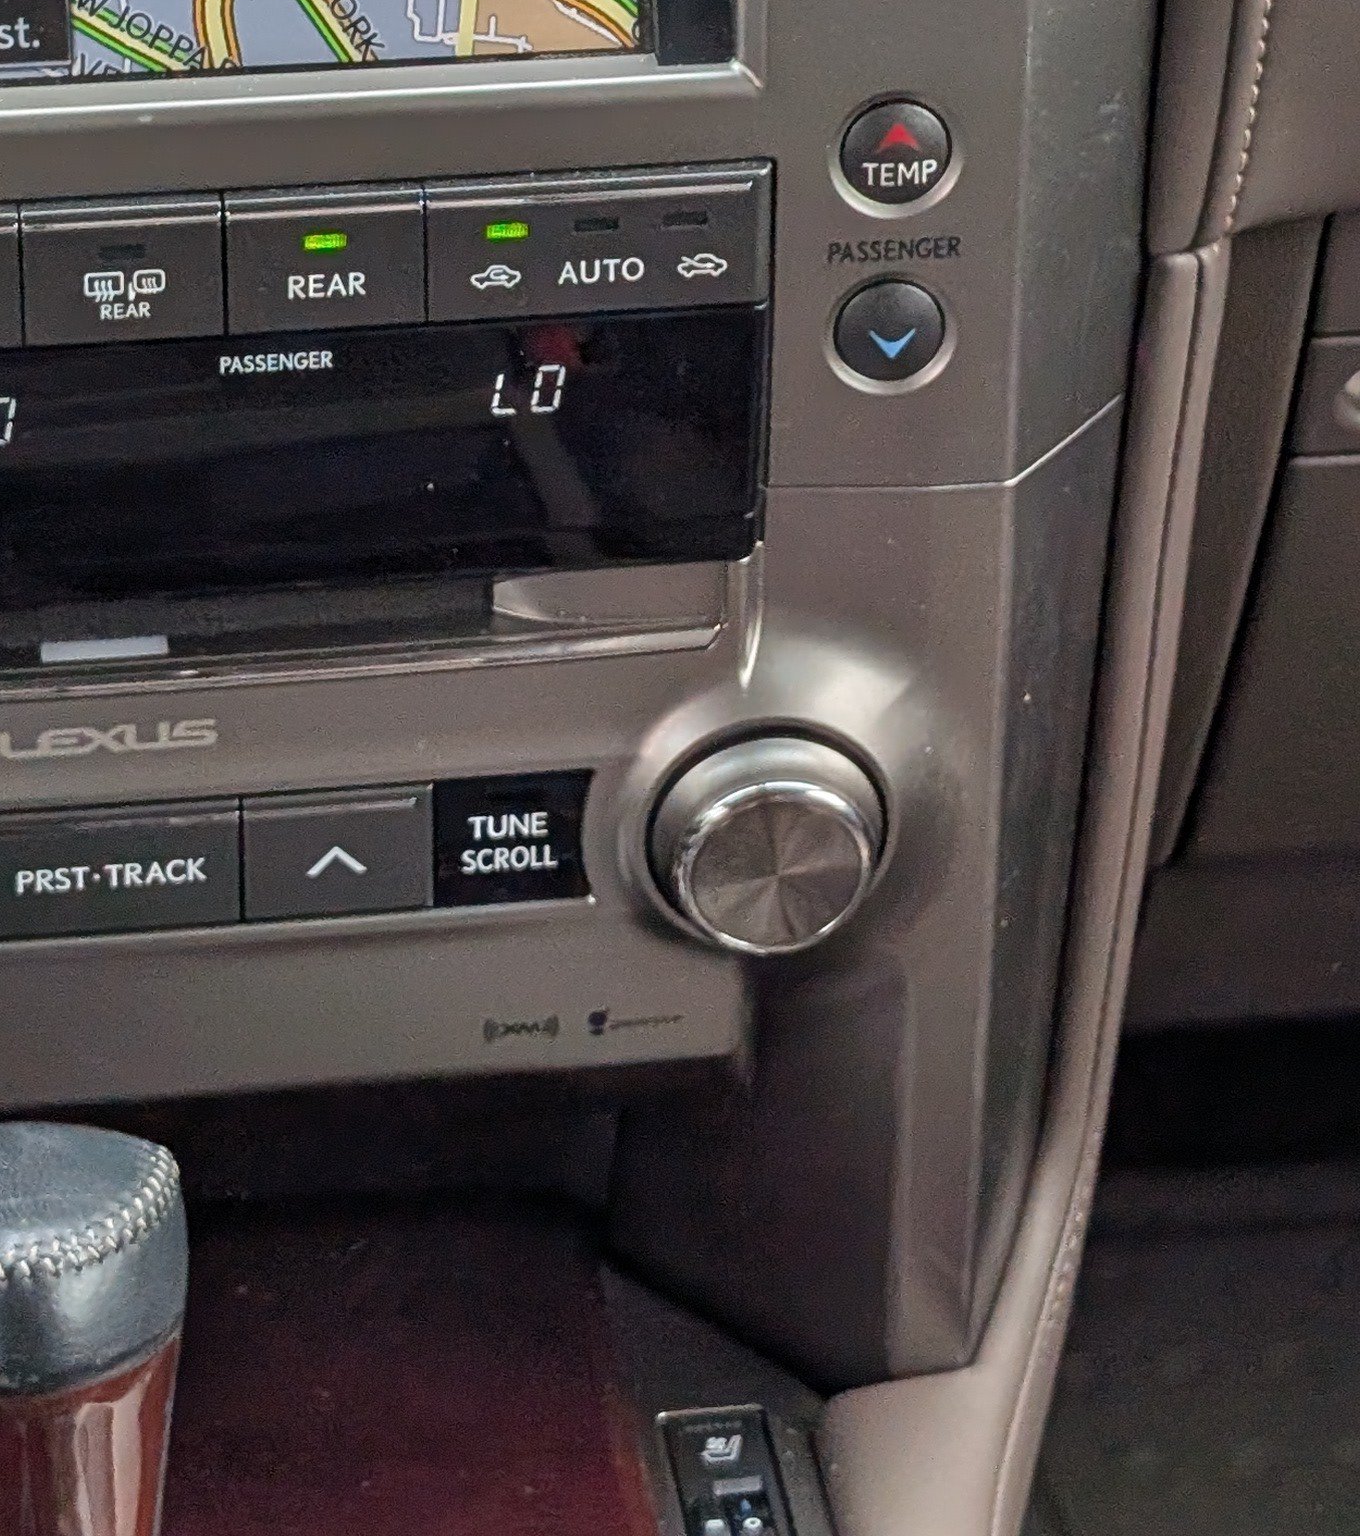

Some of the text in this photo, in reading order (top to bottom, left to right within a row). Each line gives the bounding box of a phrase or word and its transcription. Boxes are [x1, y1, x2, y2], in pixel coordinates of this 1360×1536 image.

[109, 5, 206, 70] JOPPA
[861, 158, 939, 187] TEMP
[826, 236, 962, 264] PASSENGER
[557, 257, 645, 285] AUTO
[287, 272, 367, 299] REAR
[99, 301, 152, 321] REAR
[219, 350, 334, 375] PASSENGER
[490, 363, 567, 417] LO
[467, 810, 550, 839] TUNE
[460, 842, 558, 874] SCROLL
